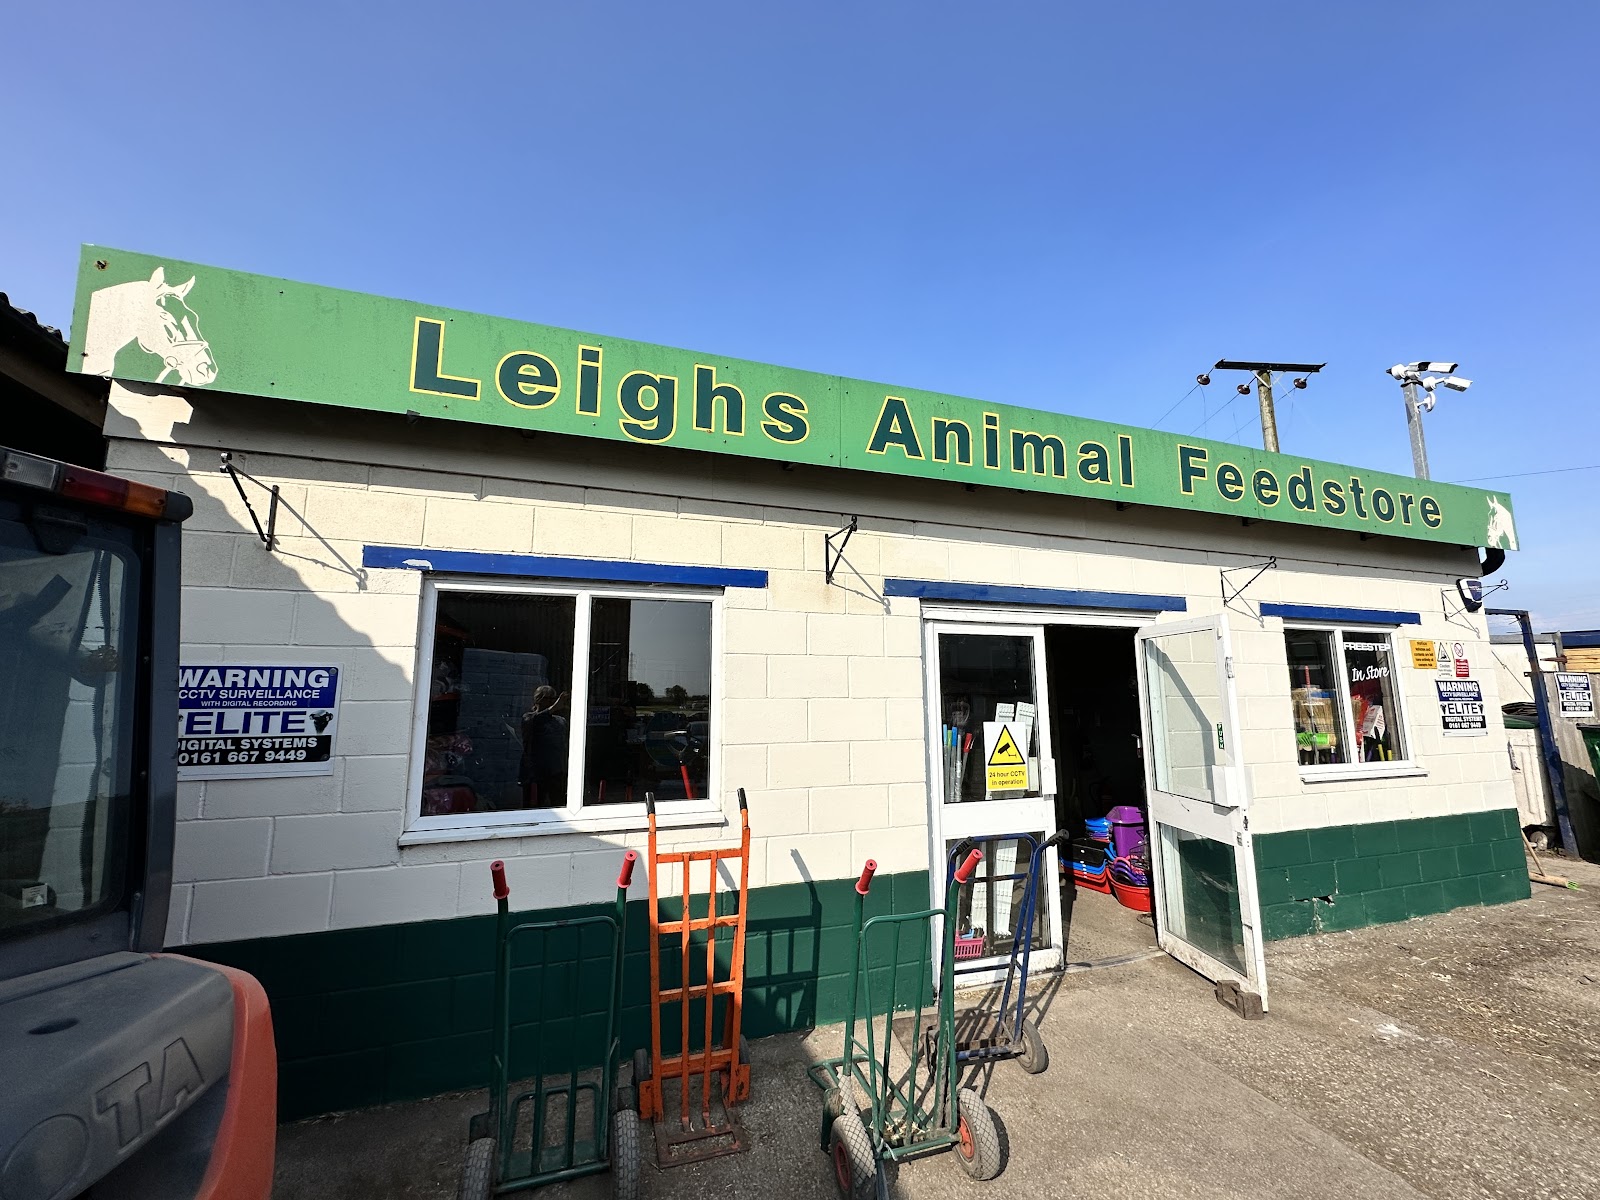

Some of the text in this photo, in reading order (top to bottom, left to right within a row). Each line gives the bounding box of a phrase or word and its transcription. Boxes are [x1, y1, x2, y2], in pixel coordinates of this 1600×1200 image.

[409, 316, 1442, 529] Leighs Animal Feedstore
[1344, 642, 1390, 651] FREESTEP
[179, 669, 329, 688] WARNING
[1351, 665, 1389, 682] In Store
[1437, 681, 1479, 692] WARNING
[178, 689, 320, 699] CCTV SURVEILLANCE
[1565, 691, 1587, 700] ELITE
[1447, 703, 1478, 714] ELITE
[185, 711, 306, 735] ELITE
[240, 737, 317, 749] SYSTEMS
[178, 750, 306, 764] 0161 667 9449
